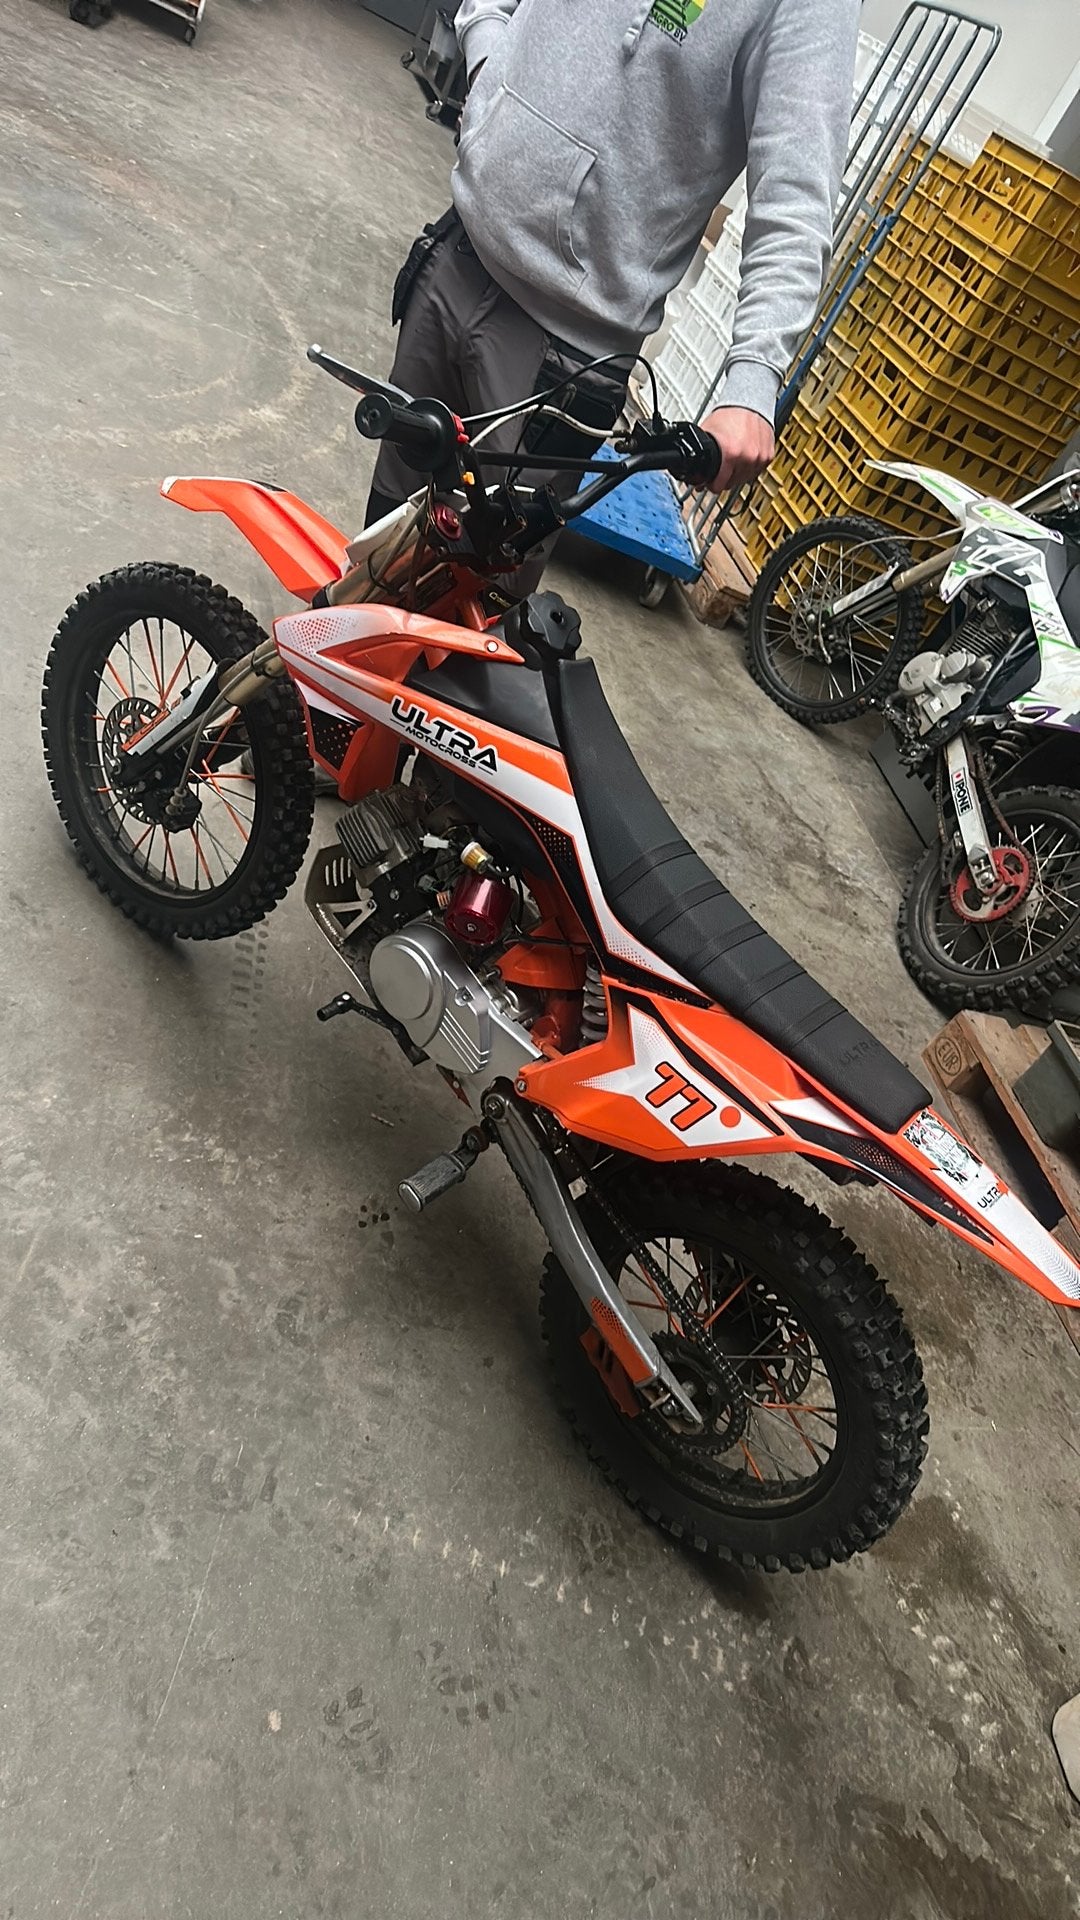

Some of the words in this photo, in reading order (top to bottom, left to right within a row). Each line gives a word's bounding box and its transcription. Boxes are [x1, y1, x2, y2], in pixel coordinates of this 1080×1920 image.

[391, 698, 498, 772] ULTRA
[405, 726, 476, 768] MOTOCROSS
[954, 778, 971, 813] IPONE
[937, 1041, 959, 1071] EUR
[645, 1061, 717, 1132] 77
[977, 1186, 1002, 1209] ULTR
